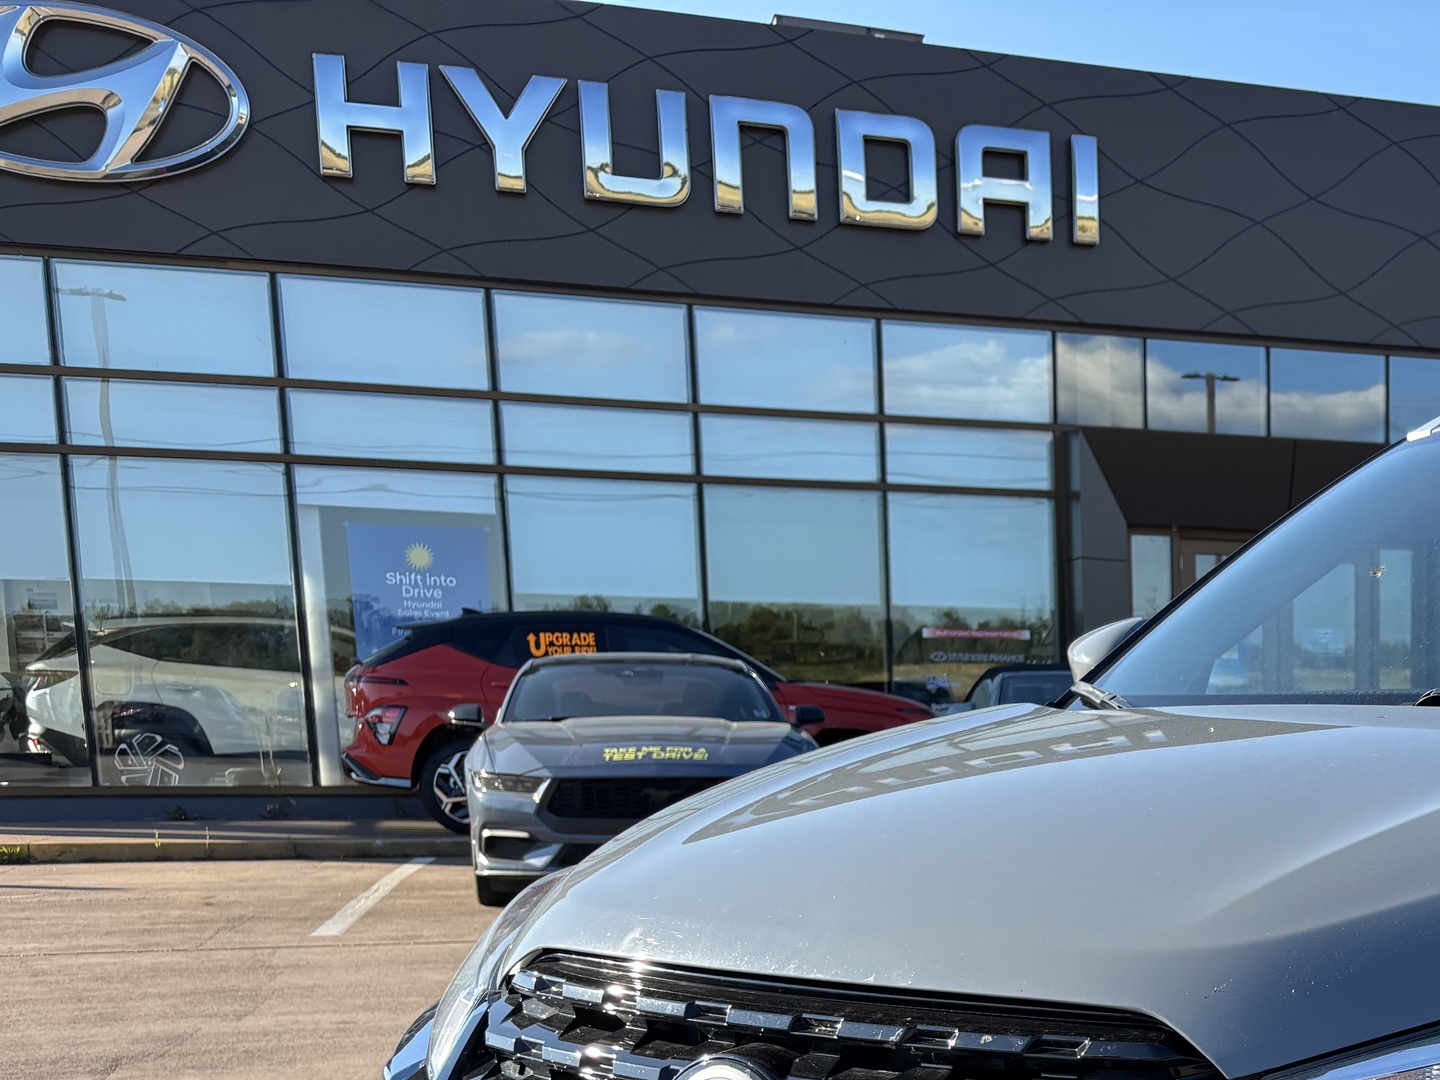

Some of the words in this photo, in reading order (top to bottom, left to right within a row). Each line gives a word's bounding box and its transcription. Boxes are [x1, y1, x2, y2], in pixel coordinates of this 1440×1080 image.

[312, 52, 1100, 246] HYUNDAI
[386, 571, 422, 586] Shift
[426, 573, 457, 587] into
[402, 585, 443, 599] Drive
[527, 632, 596, 657] UPGRADE
